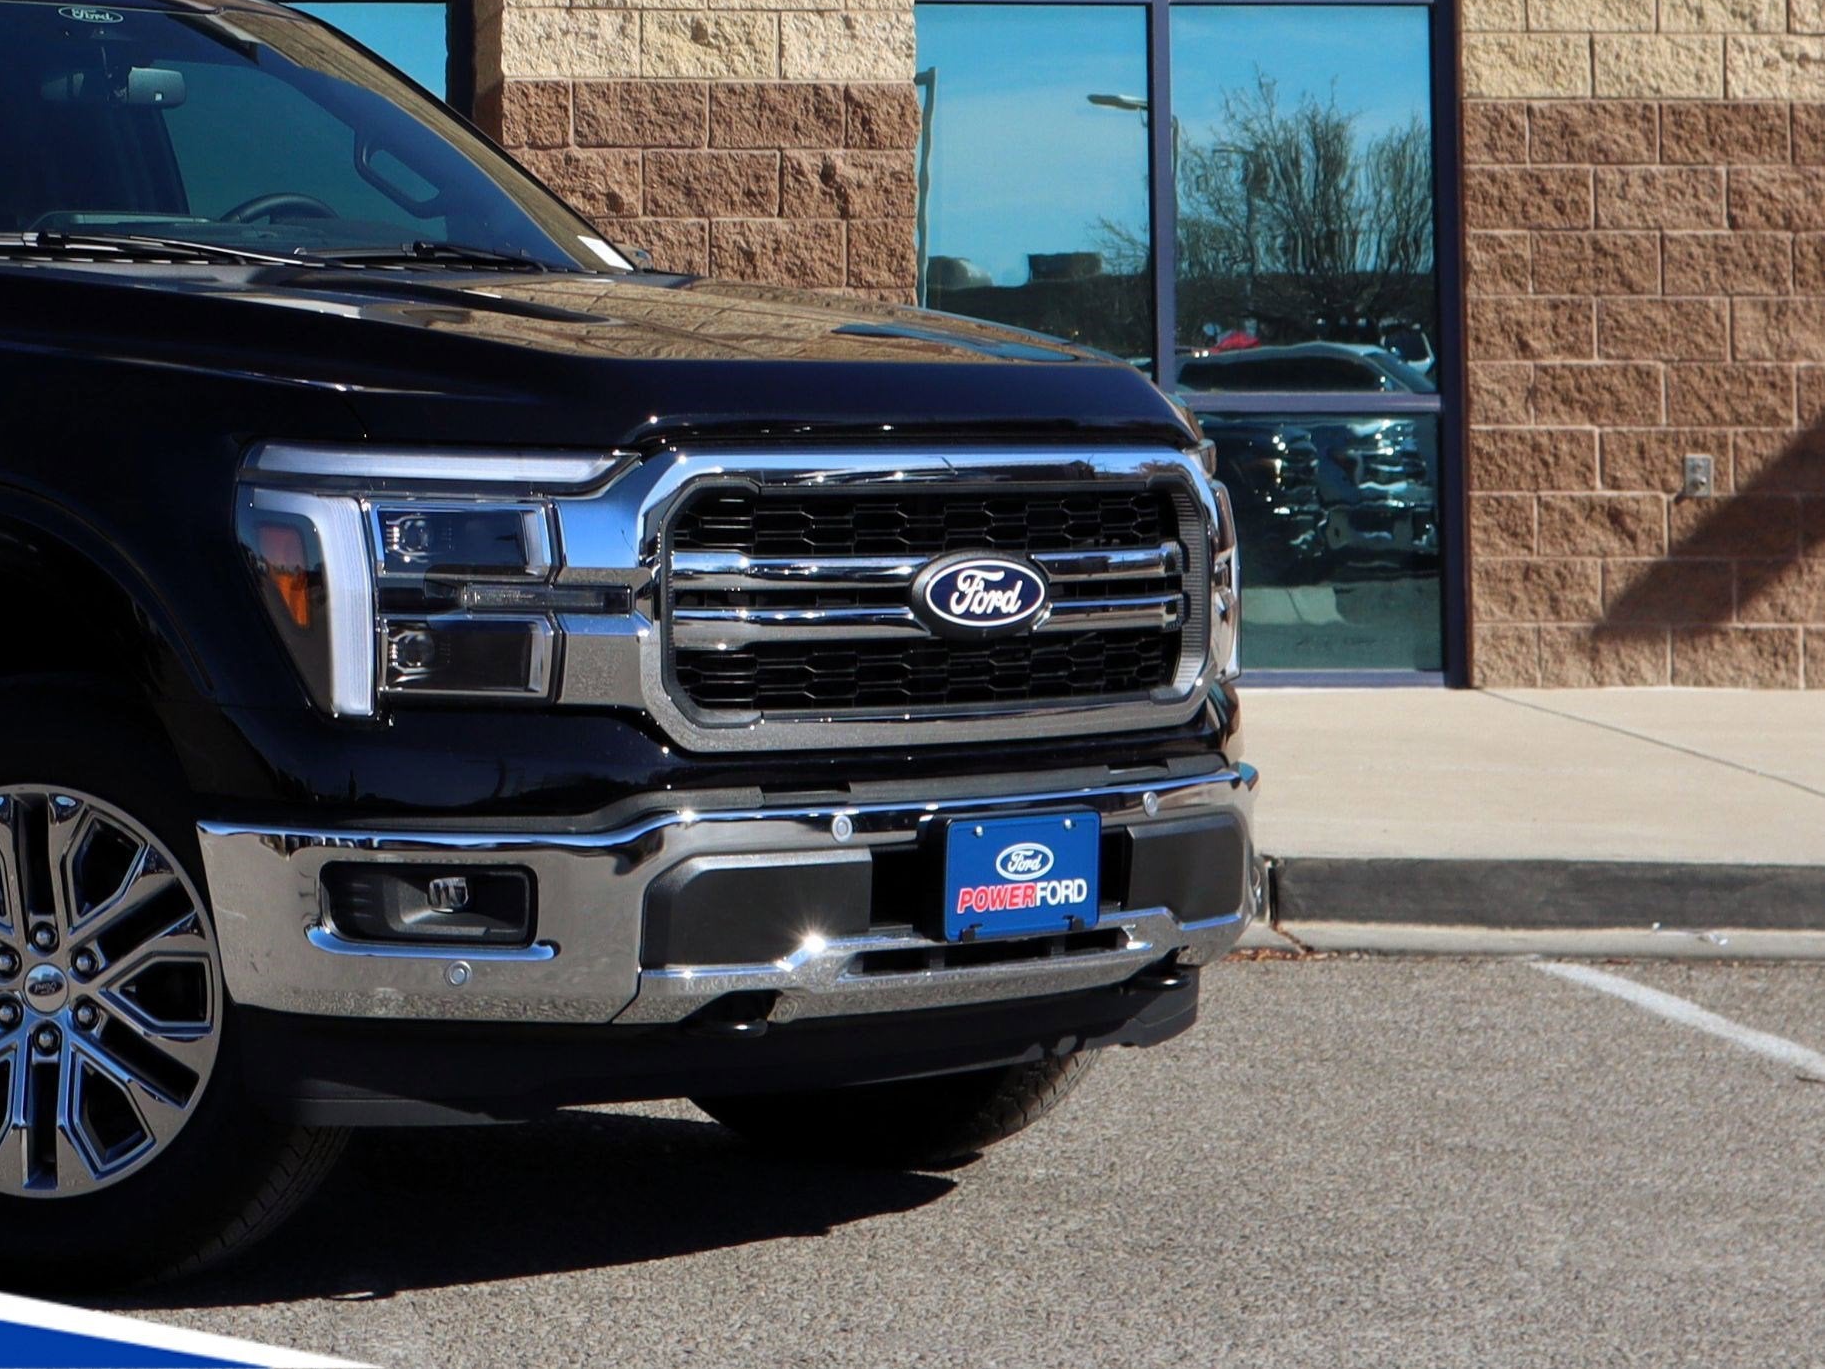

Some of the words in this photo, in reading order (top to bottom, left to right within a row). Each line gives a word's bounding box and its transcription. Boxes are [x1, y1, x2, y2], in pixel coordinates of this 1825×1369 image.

[950, 570, 1023, 615] Ford
[1007, 850, 1042, 872] Ford
[957, 878, 1087, 914] POWERFORD
